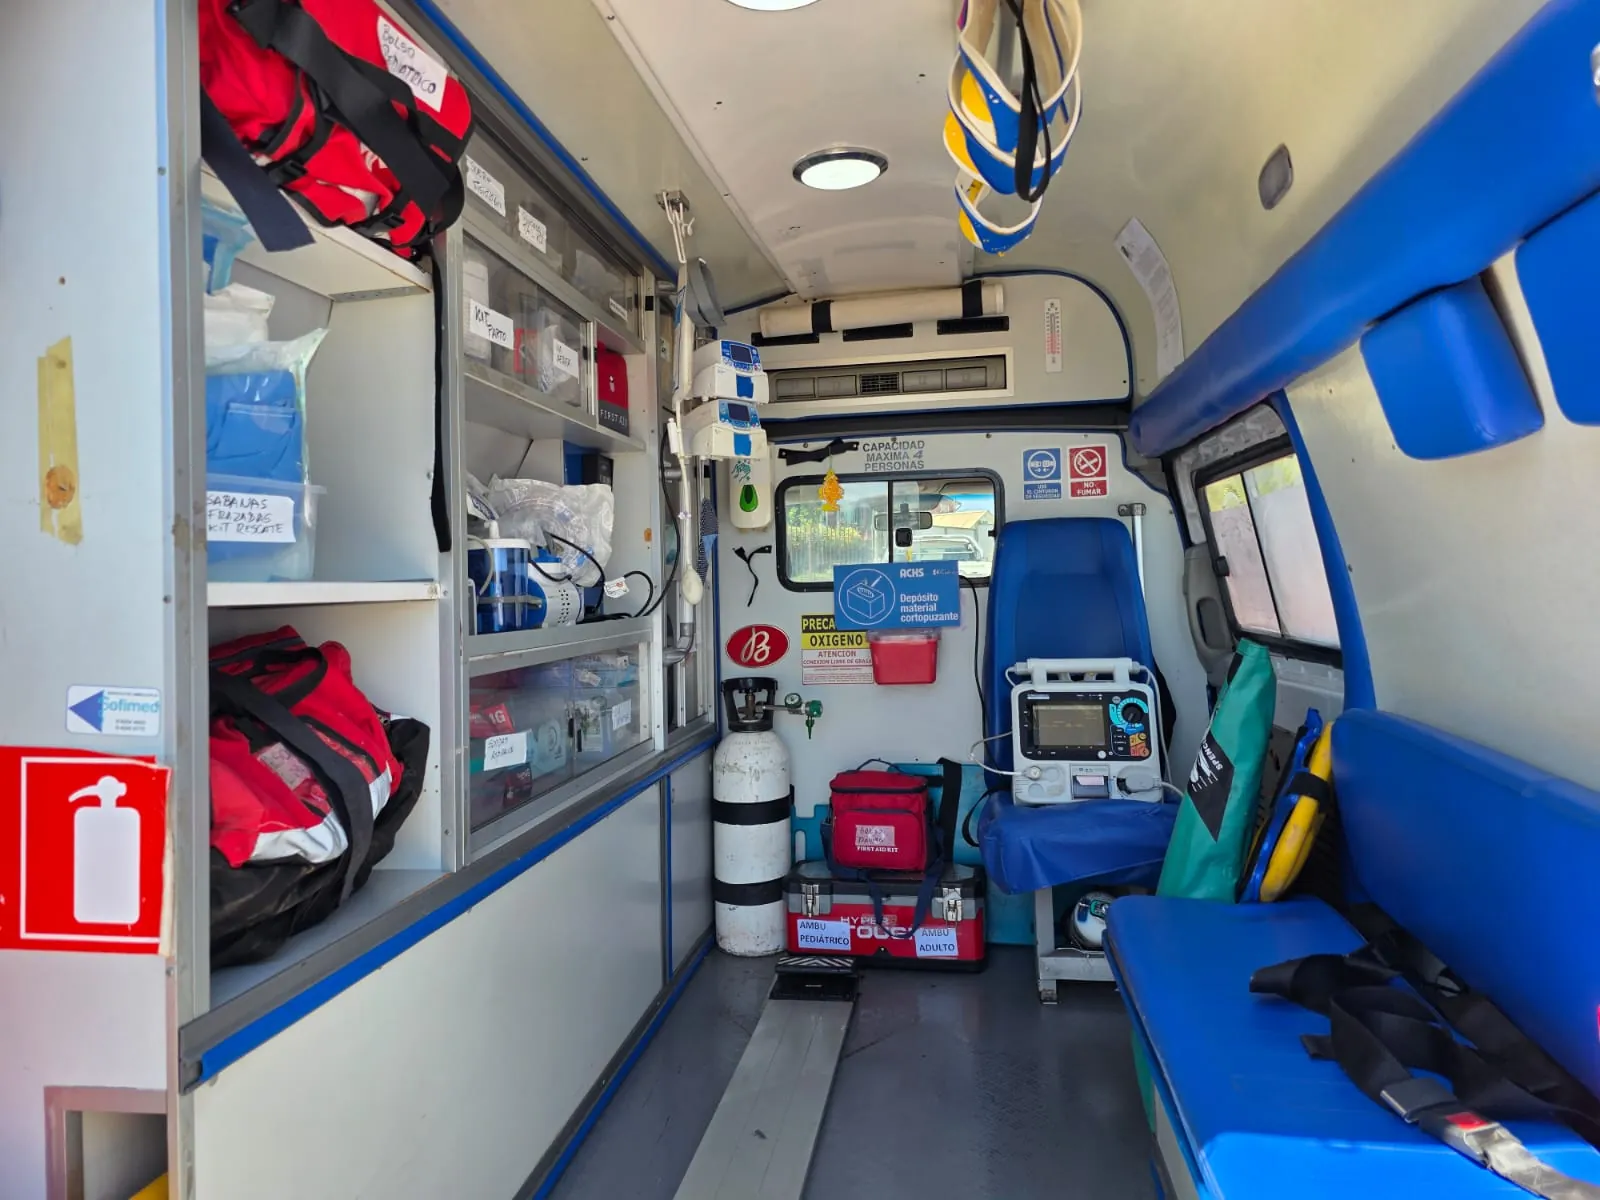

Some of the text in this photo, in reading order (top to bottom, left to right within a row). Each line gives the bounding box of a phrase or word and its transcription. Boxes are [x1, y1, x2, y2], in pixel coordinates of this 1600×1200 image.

[862, 440, 925, 452] CAPACIDAD
[866, 450, 924, 462] MAXIMA 4
[864, 460, 925, 472] PERSONAS
[900, 568, 924, 578] ACHS
[900, 593, 939, 604] Depósito
[900, 603, 937, 613] material
[802, 618, 836, 630] PRECA
[809, 634, 863, 647] OXIGENO
[1202, 742, 1223, 770] SPENC
[800, 920, 827, 931] AMBU
[921, 928, 950, 937] AMBU
[800, 933, 850, 946] PEDIÁTRICO
[919, 943, 955, 953] ADULTO
